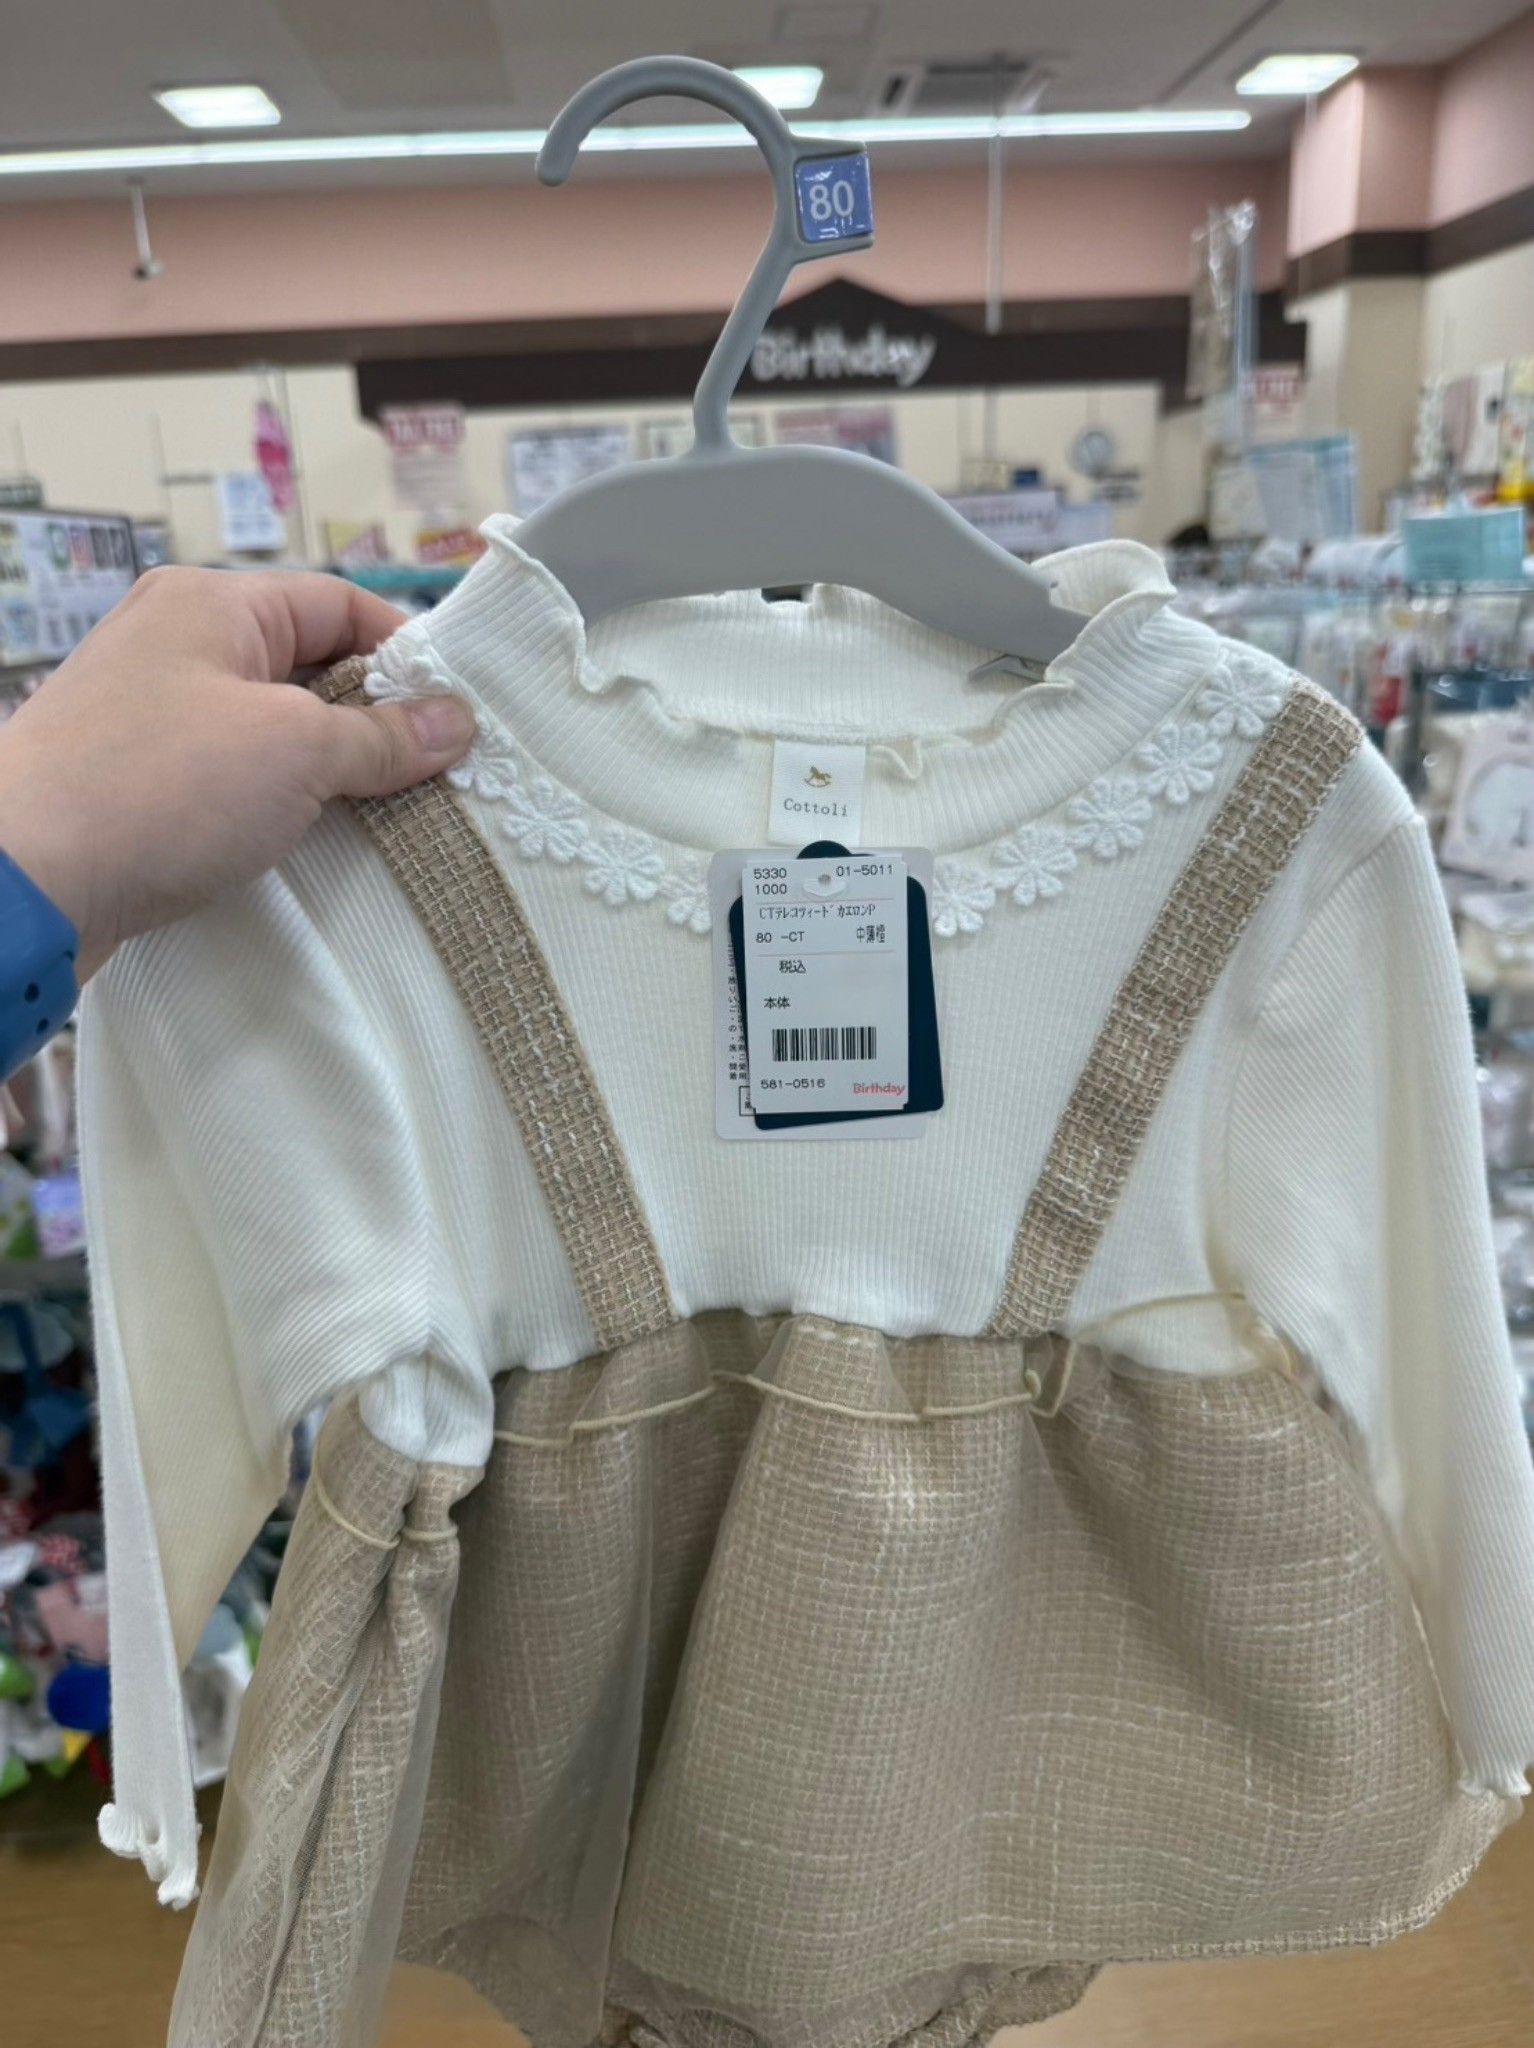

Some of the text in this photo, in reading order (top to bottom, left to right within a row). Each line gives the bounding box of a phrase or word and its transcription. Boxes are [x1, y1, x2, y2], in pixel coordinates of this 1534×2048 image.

[809, 180, 855, 221] 80
[751, 325, 937, 387] Birthday
[783, 798, 848, 818] Cottoli
[753, 864, 893, 880] 5330 01-5011
[755, 883, 788, 896] 1000
[755, 931, 773, 944] 80
[778, 959, 807, 975] 税込
[763, 996, 791, 1010] 本体
[760, 1078, 826, 1090] 581-0516
[853, 1083, 906, 1097] Birthday
